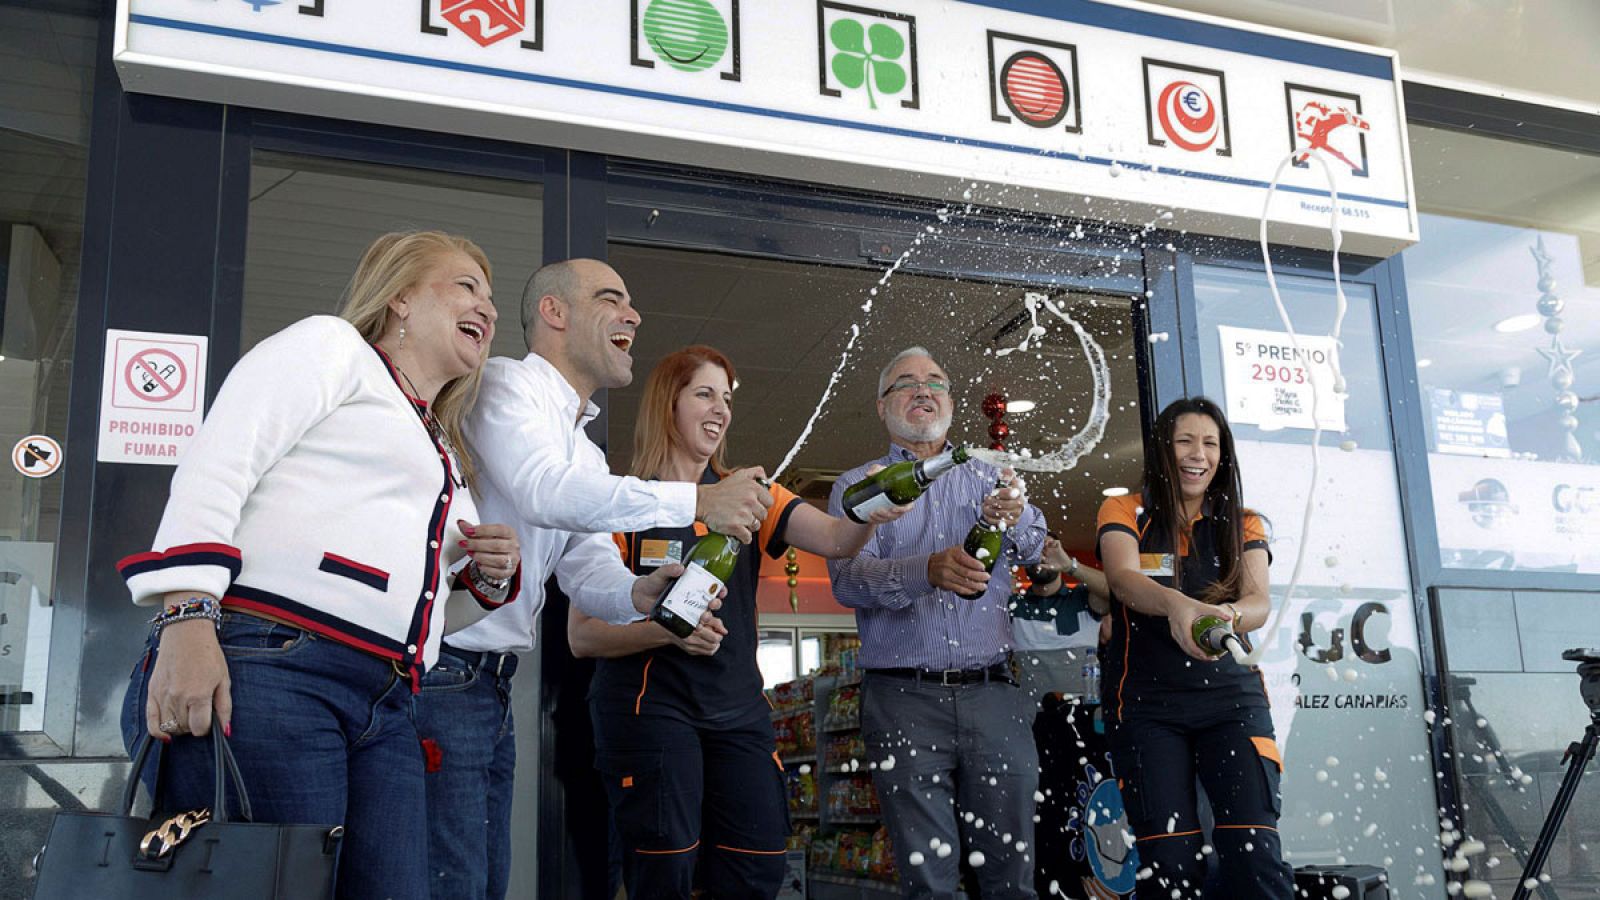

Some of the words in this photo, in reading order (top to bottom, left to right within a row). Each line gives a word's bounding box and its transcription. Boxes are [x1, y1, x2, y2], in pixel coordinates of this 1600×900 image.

[1251, 364, 1311, 384] 2903
[109, 420, 195, 437] PROHIBIDO
[124, 442, 177, 457] FUMAR
[1285, 693, 1330, 708] ALEZ
